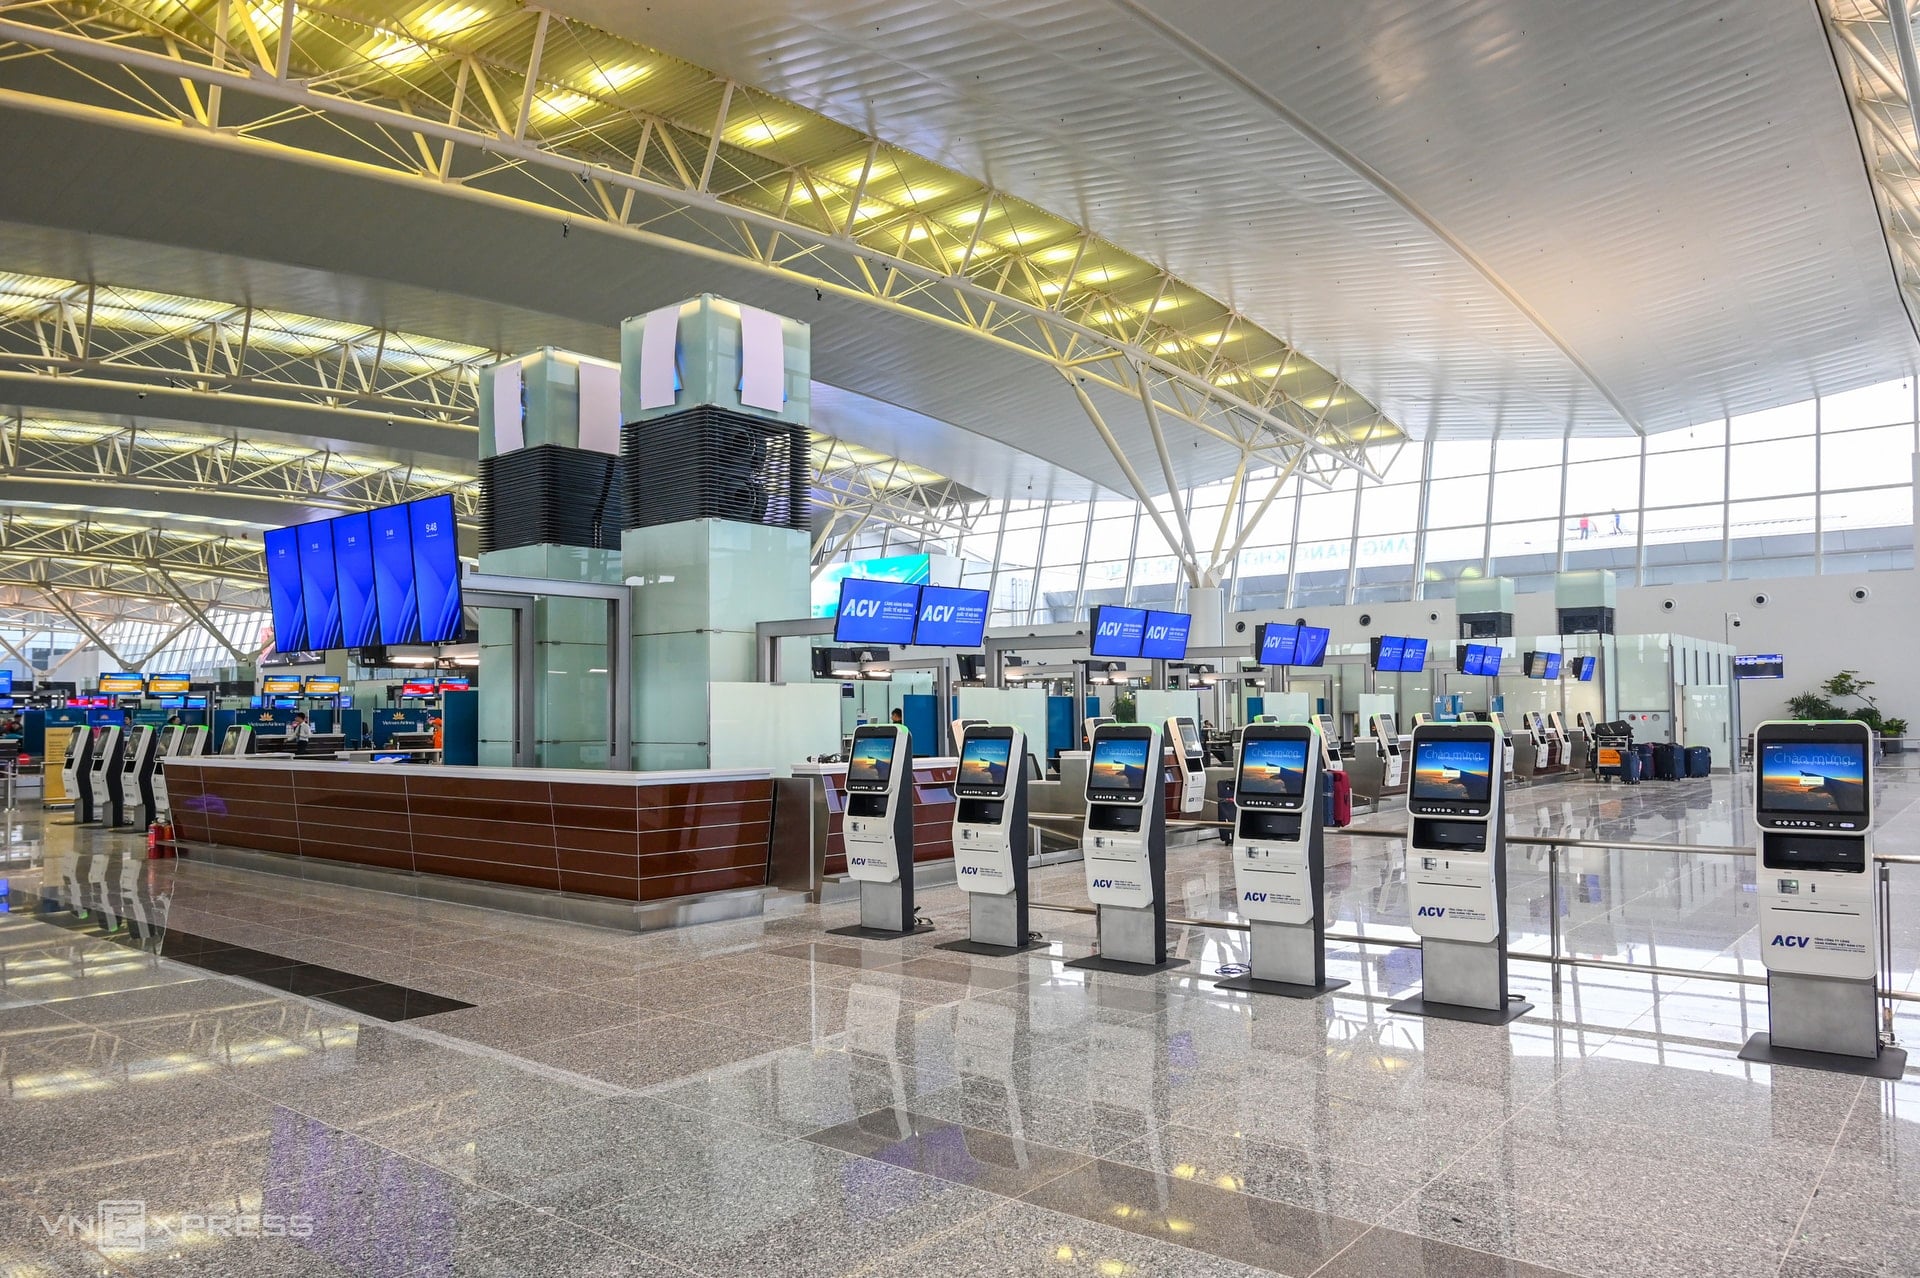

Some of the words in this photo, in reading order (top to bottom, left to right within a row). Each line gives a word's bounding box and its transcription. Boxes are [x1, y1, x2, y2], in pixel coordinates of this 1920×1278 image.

[425, 522, 438, 533] 9:48
[842, 598, 881, 618] ACV
[920, 604, 955, 622] ACV
[1097, 621, 1122, 637] ACV
[1146, 625, 1168, 640] ACV
[1264, 636, 1281, 648] ACV
[1380, 647, 1392, 658] ACV
[1403, 648, 1415, 659] ACV
[1774, 752, 1807, 763] Chào
[851, 857, 866, 865] ACV
[961, 866, 978, 875] ACV
[1093, 879, 1112, 888] ACV
[1244, 892, 1267, 902] ACV
[1418, 906, 1445, 917] ACV
[1771, 935, 1810, 948] ACV
